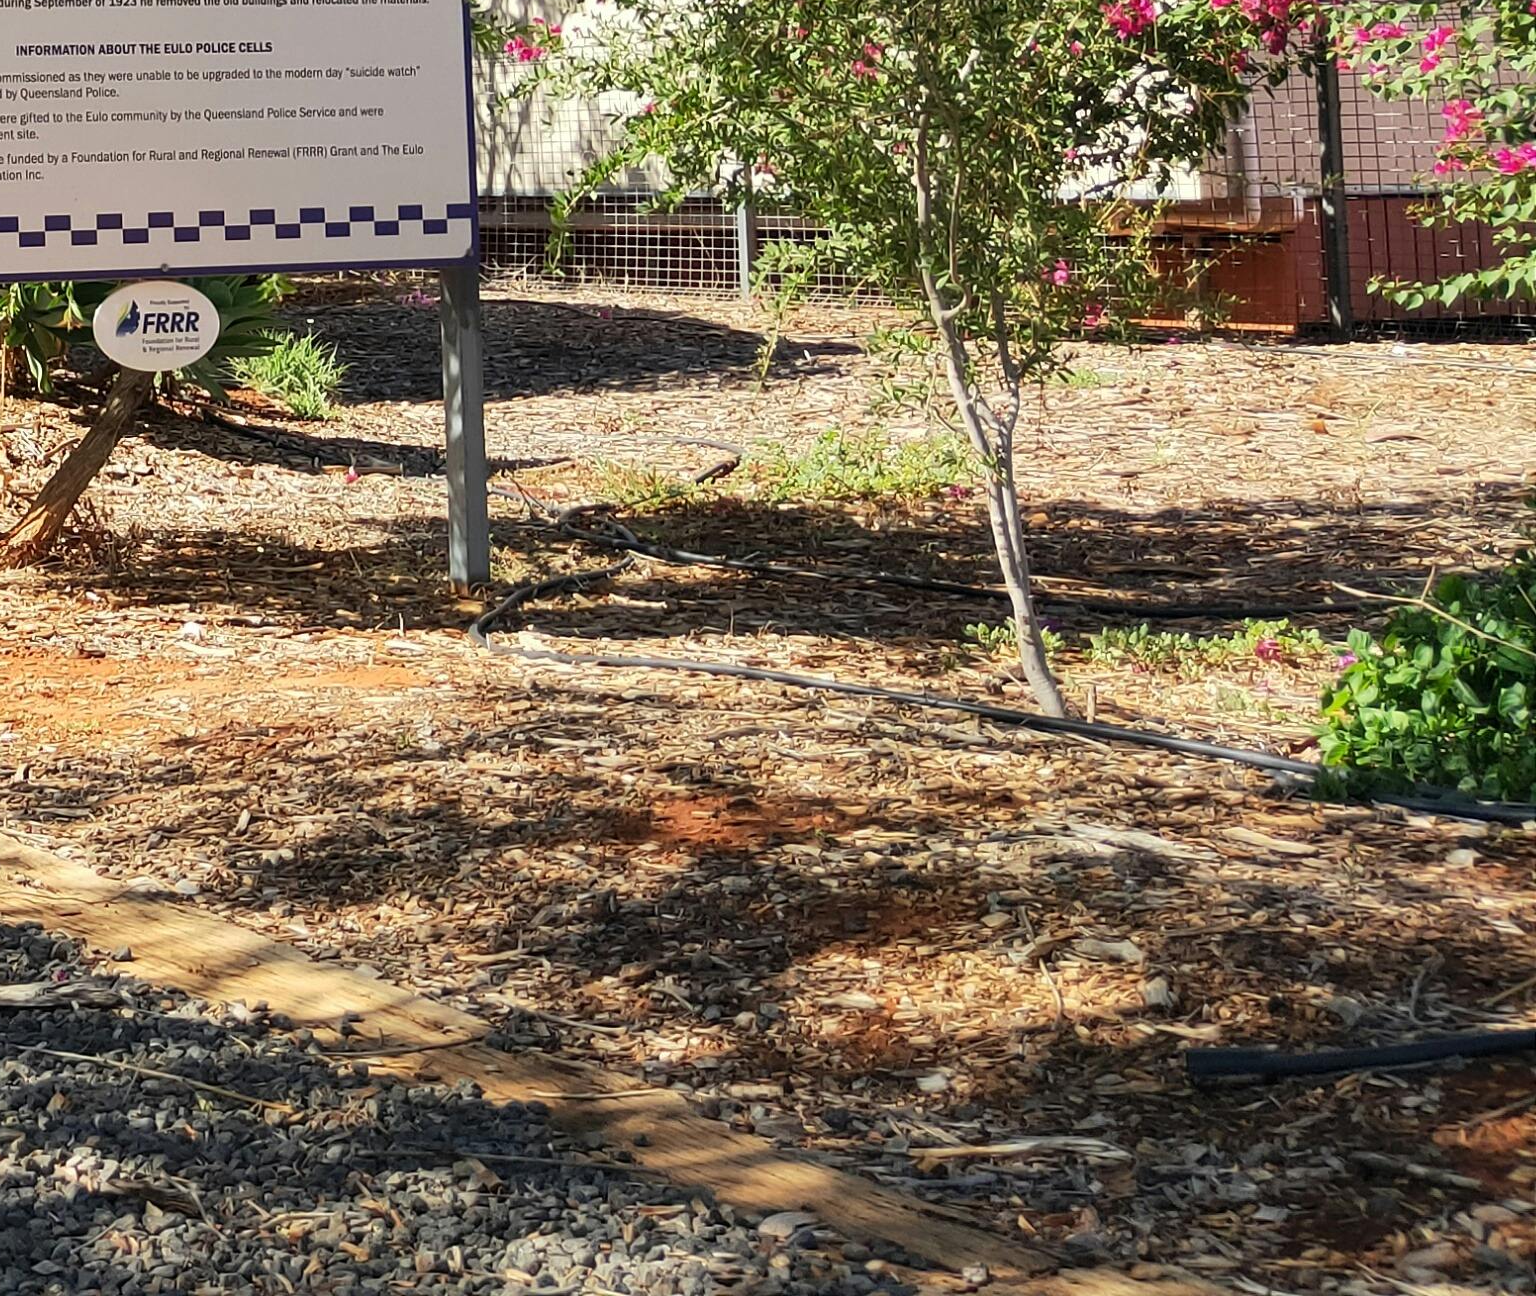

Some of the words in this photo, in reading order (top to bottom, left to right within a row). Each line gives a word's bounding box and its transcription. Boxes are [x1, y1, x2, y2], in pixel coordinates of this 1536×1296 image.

[15, 44, 95, 56] INFORMATION
[97, 43, 137, 54] ABOUT
[138, 43, 161, 54] THE
[163, 42, 193, 54] EULO
[195, 42, 236, 53] POLICE
[238, 41, 273, 52] CELLS
[68, 73, 81, 82] as
[83, 71, 106, 84] they
[107, 72, 133, 81] were
[135, 69, 171, 80] unable
[173, 70, 184, 80] to
[186, 68, 199, 80] be
[202, 68, 250, 82] upgraded
[252, 68, 263, 79] to
[265, 68, 282, 78] the
[284, 67, 323, 78] modern
[325, 67, 343, 79] day
[5, 88, 17, 101] by
[19, 87, 82, 100] Queensland
[85, 86, 119, 97] Police.
[19, 111, 49, 125] gifted
[52, 112, 63, 123] to
[65, 112, 83, 122] the
[85, 110, 108, 122] Eulo
[110, 110, 168, 122] community
[170, 109, 182, 122] by
[184, 109, 201, 120] the
[203, 108, 264, 121] Queensland
[267, 107, 296, 118] Police
[298, 106, 336, 117] Service
[338, 105, 357, 117] and
[359, 107, 384, 116] were
[6, 152, 44, 164] funded
[46, 152, 59, 165] by
[61, 154, 68, 163] a
[71, 151, 129, 162] Foundation
[132, 150, 146, 161] for
[149, 149, 176, 160] Rural
[178, 149, 198, 160] and
[201, 147, 245, 161] Regional
[247, 147, 290, 158] Renewal
[292, 145, 327, 159] (FRRR)
[329, 145, 358, 156] Grant
[359, 144, 379, 155] and
[381, 144, 399, 155] The
[402, 143, 424, 154] Eulo
[25, 169, 44, 180] Inc.
[142, 311, 200, 334] FRRR
